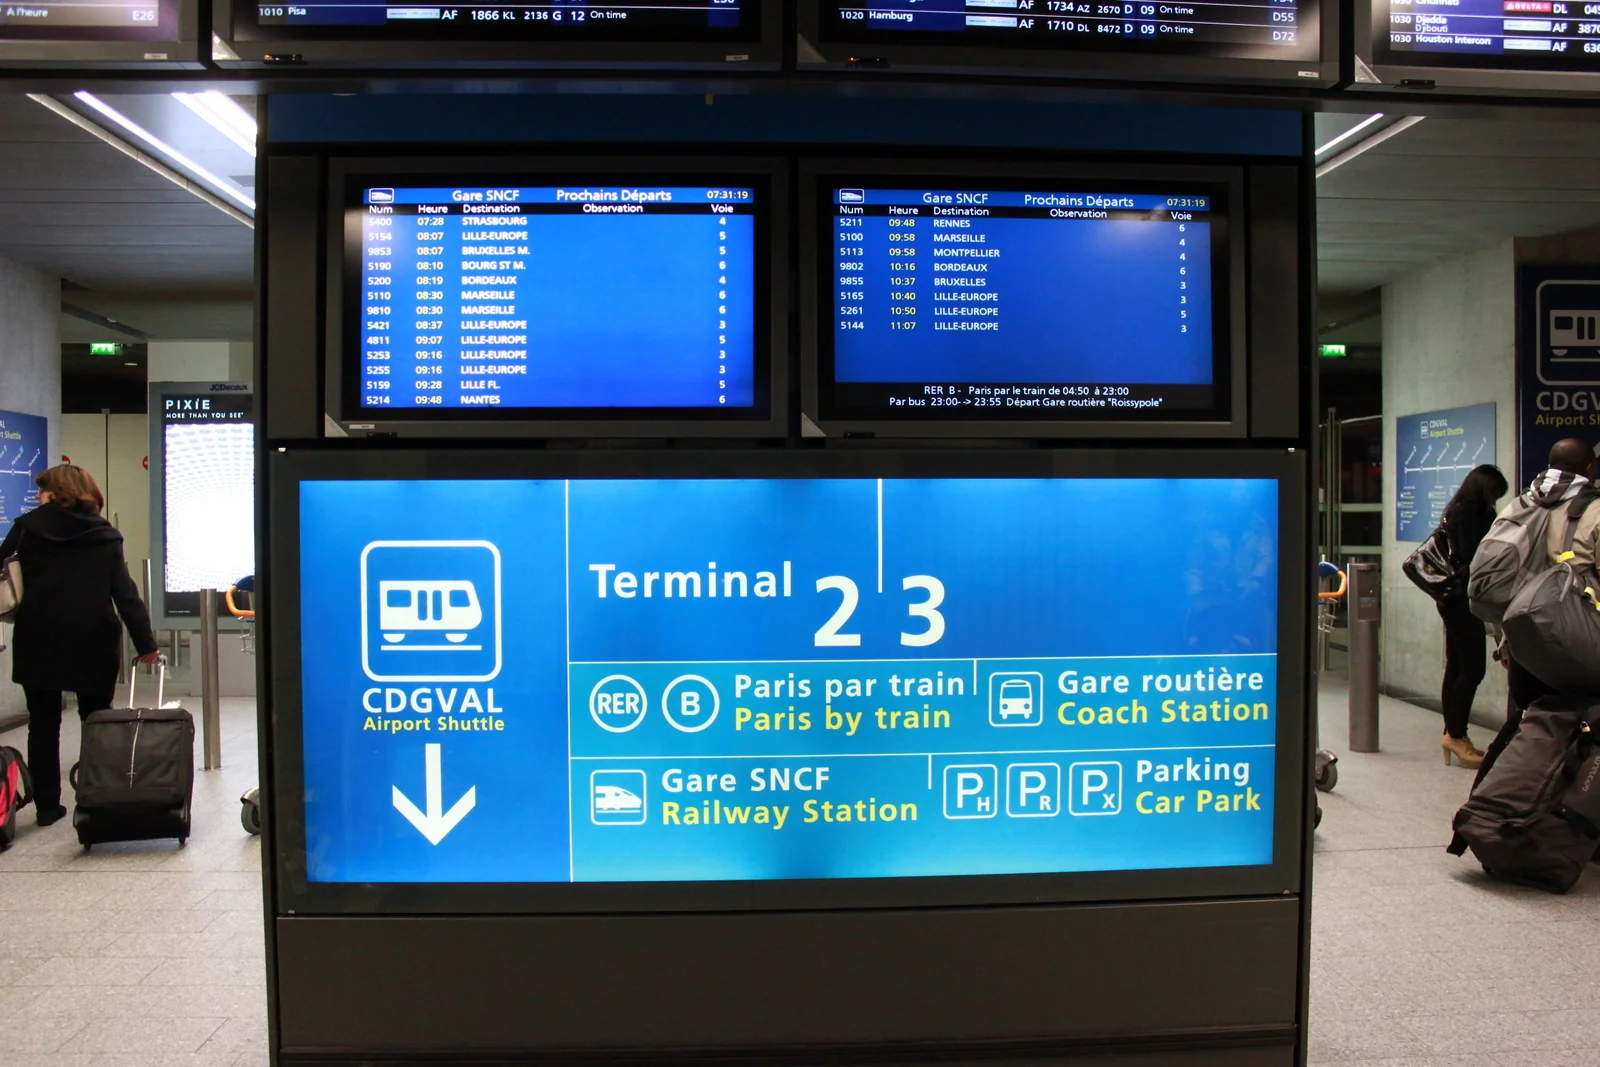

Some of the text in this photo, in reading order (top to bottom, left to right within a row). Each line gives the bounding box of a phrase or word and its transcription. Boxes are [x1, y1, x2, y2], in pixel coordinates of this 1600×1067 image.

[133, 10, 154, 20] E26
[260, 8, 282, 16] 1010
[288, 7, 306, 15] Pisa
[442, 10, 457, 19] AF
[472, 11, 499, 20] 1866
[1019, 0, 1034, 9] AF
[1047, 1, 1074, 11] 1734
[1175, 6, 1193, 14] time
[1273, 12, 1294, 22] D55
[841, 11, 863, 19] 1020
[869, 11, 913, 22] Hamburg
[1019, 19, 1034, 28] AF
[1048, 21, 1074, 30] 1710
[1098, 25, 1120, 33] 8472
[1272, 31, 1294, 41] D72
[452, 189, 748, 203] Gare SNCF Prochains Départs 07:31:19
[923, 193, 952, 203] Gare
[956, 193, 988, 203] SNCF
[1025, 194, 1083, 205] Prochains
[1087, 196, 1134, 209] Départs
[368, 203, 733, 215] Num Heure Destination Observation Voie
[889, 206, 918, 214] Heure
[934, 207, 989, 215] Destination
[1050, 209, 1107, 218] Observation
[1171, 212, 1191, 220] Voie
[462, 217, 527, 225] STRASBOURG
[840, 218, 861, 226] 5211
[462, 232, 527, 240] LILLE-EUROPE
[840, 233, 863, 241] 5100
[934, 234, 985, 242] MARSEILLE
[462, 246, 530, 255] BRUXELLES M.
[889, 248, 915, 256] 09:58
[934, 249, 1000, 257] MONTPELLIER
[462, 261, 525, 270] BOURG ST M.
[840, 262, 863, 270] 9802
[934, 263, 987, 271] BORDEAUX
[462, 276, 516, 284] BORDEAUX
[840, 277, 863, 285] 9855
[935, 278, 986, 286] BRUXELLES
[462, 291, 515, 299] MARSEILLE
[891, 292, 915, 300] 10:40
[935, 293, 998, 301] LILLE-EUROPE
[461, 306, 514, 314] MARSEILLE
[461, 320, 527, 329] LILLE-EUROPE
[935, 322, 998, 330] LILLE-EUROPE
[461, 335, 526, 344] LILLE-EUROPE
[461, 350, 526, 359] LILLE-EUROPE
[461, 365, 526, 374] LILLE-EUROPE
[461, 380, 501, 389] LILLE FL.
[925, 386, 943, 394] RER
[949, 386, 955, 394] B
[969, 386, 991, 394] Paris
[994, 388, 1010, 396] par
[1013, 386, 1020, 394] le
[1049, 386, 1060, 395] de
[1063, 387, 1089, 395] 04:50
[1095, 387, 1100, 395] à
[1103, 387, 1129, 395] 23:00
[461, 395, 500, 404] NANTES
[890, 397, 906, 405] Par
[909, 397, 925, 405] bus
[975, 398, 1001, 406] 23:55
[1007, 398, 1040, 408] Départ
[1043, 398, 1065, 406] Gare
[1068, 398, 1105, 406] routière
[1108, 398, 1162, 408] "Roissypole"
[1535, 414, 1584, 427] Airport
[589, 561, 945, 646] Terminal 2 3
[1058, 667, 1263, 694] Gare routière
[598, 671, 963, 715] RER B Paris par train
[363, 688, 502, 713] CDGVAL
[1058, 698, 1268, 725] Coach Station
[364, 716, 504, 734] Airport Shuttle
[736, 704, 950, 736] Paris by train
[1137, 757, 1249, 786] Parking
[662, 767, 829, 792] Gare SNCF
[1136, 787, 1260, 814] Car Park
[663, 798, 917, 830] Railway Station
